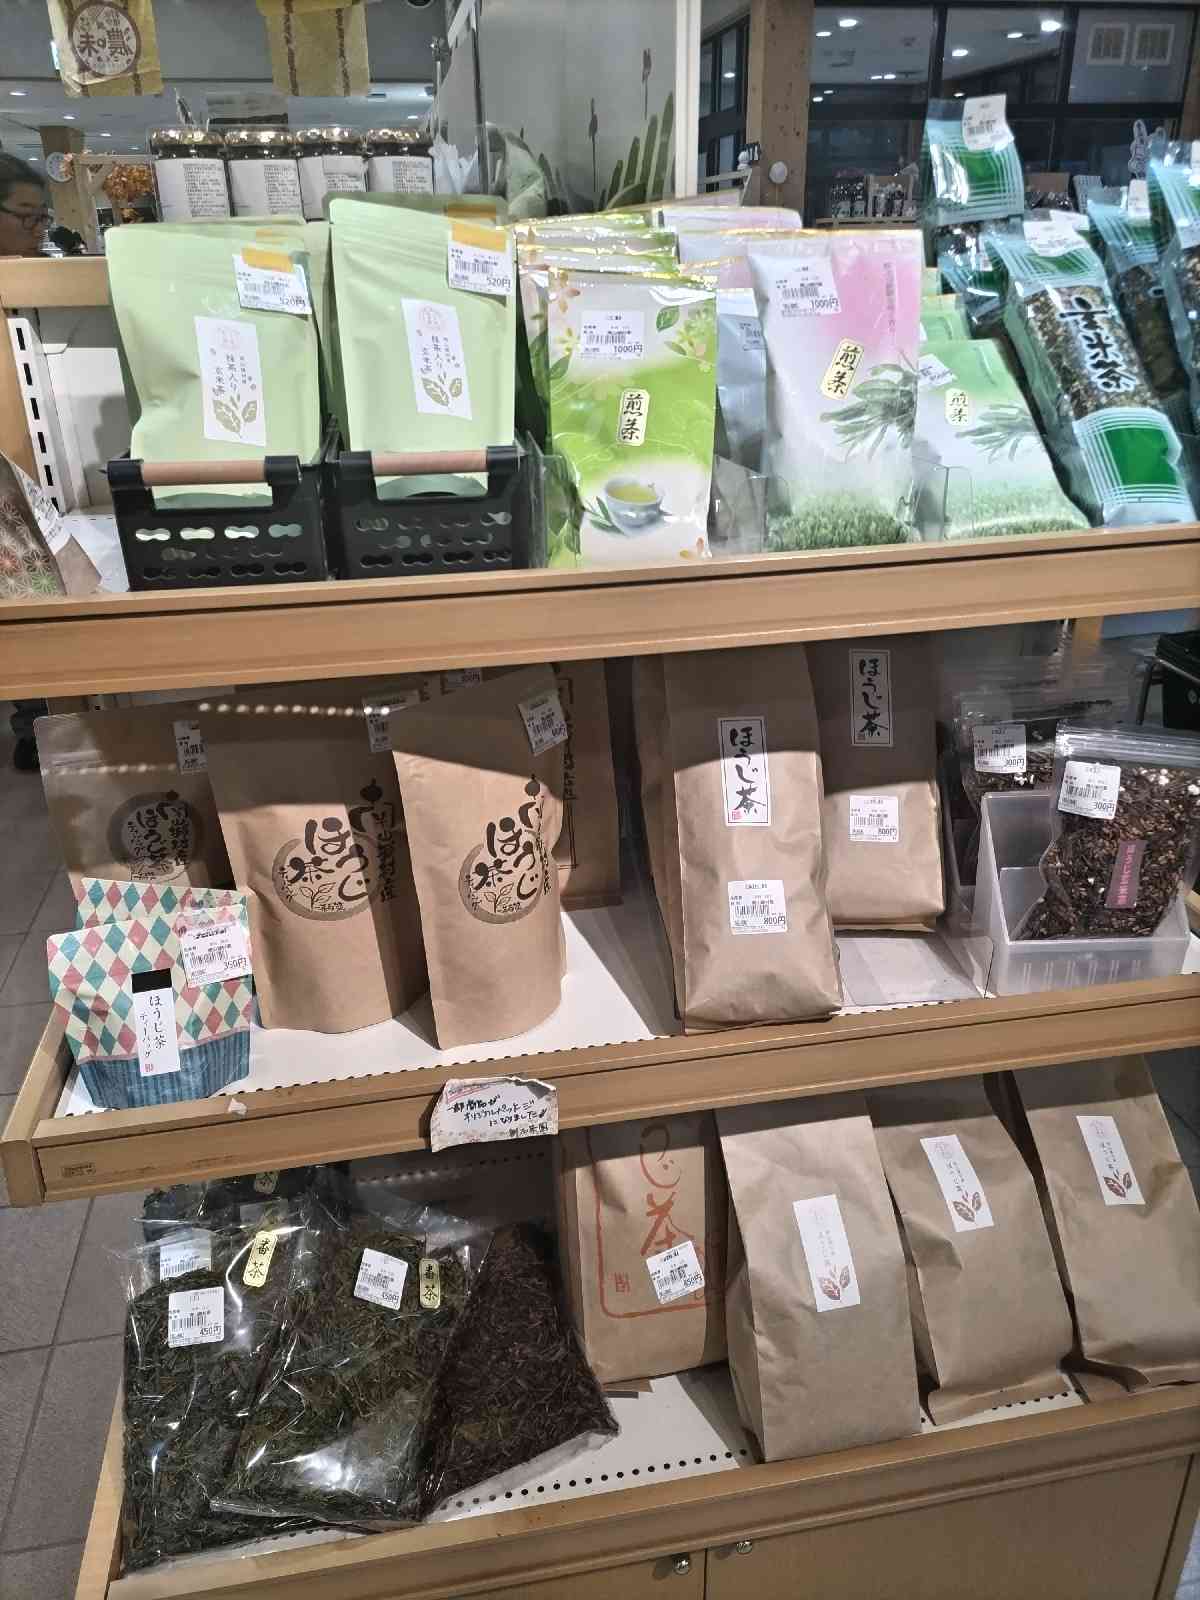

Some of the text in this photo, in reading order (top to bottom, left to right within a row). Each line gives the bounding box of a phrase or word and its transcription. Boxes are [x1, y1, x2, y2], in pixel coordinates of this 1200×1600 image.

[614, 344, 643, 353] 1000円
[827, 345, 861, 395] 煎茶
[621, 393, 644, 440] 煎茶
[860, 657, 889, 737] ほうじ茶
[729, 726, 766, 814] ほうじ茶
[149, 995, 168, 1050] ほうじ茶
